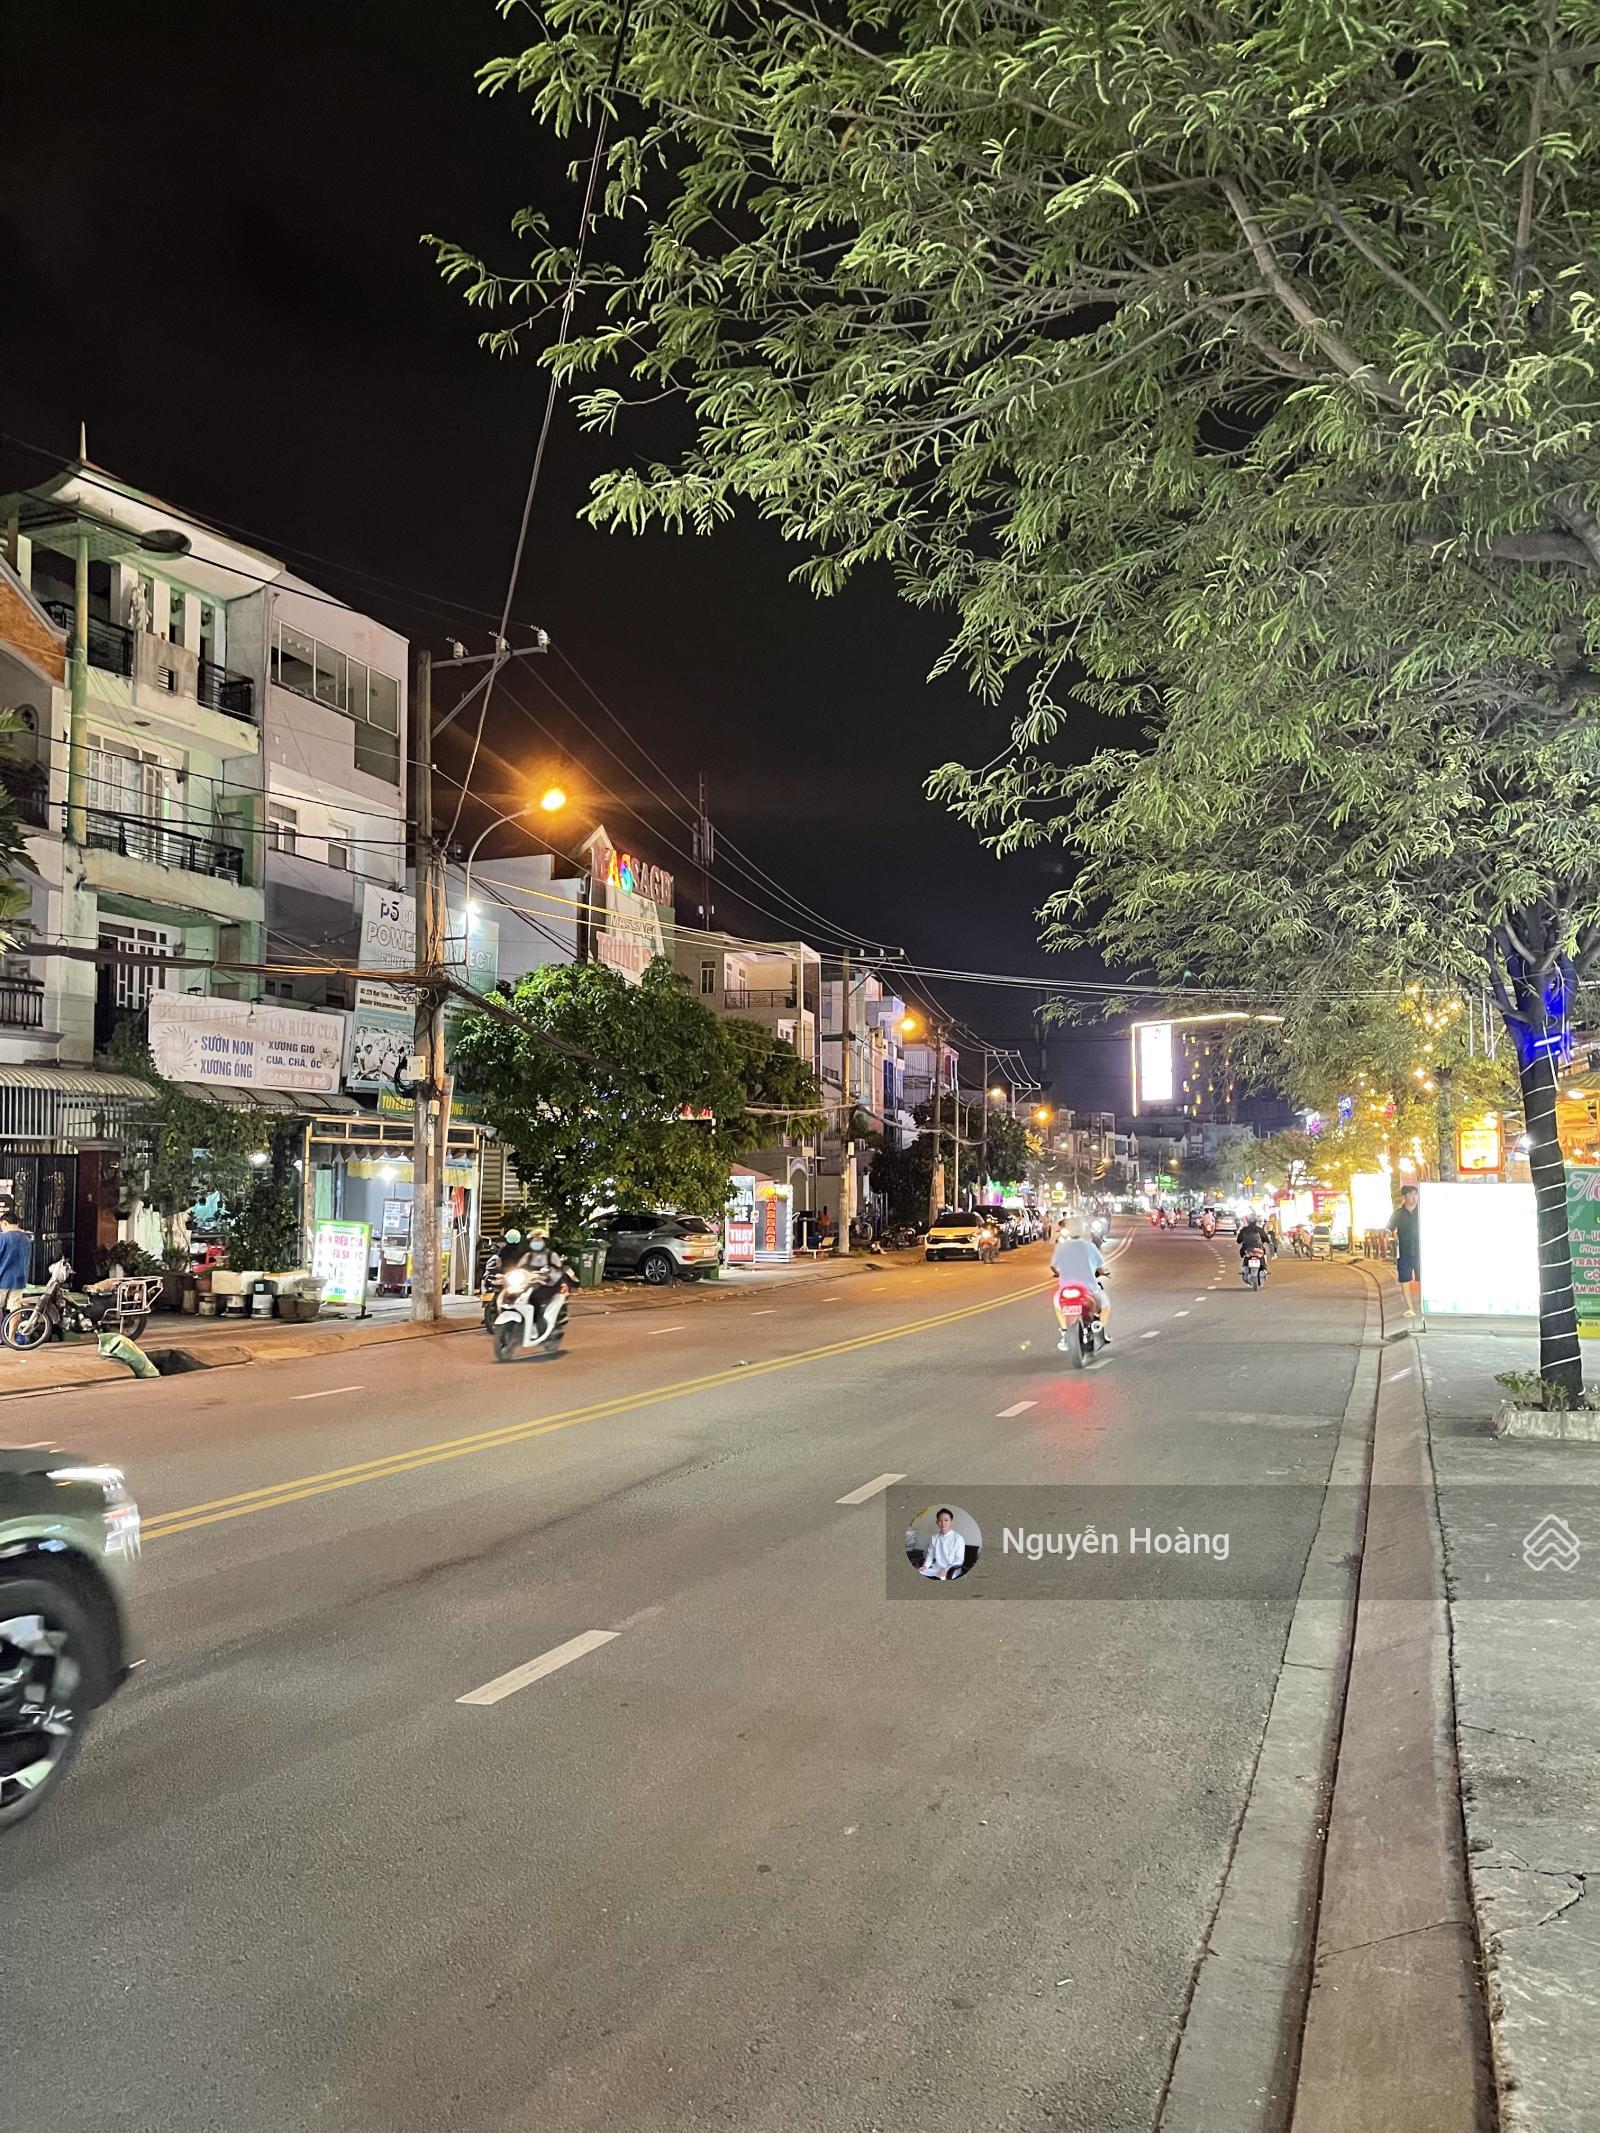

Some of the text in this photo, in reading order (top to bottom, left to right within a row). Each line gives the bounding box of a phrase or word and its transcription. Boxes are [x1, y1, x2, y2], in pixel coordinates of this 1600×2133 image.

[367, 921, 416, 953] POWE
[232, 1039, 253, 1056] NON
[200, 1058, 232, 1076] XƯƠNG
